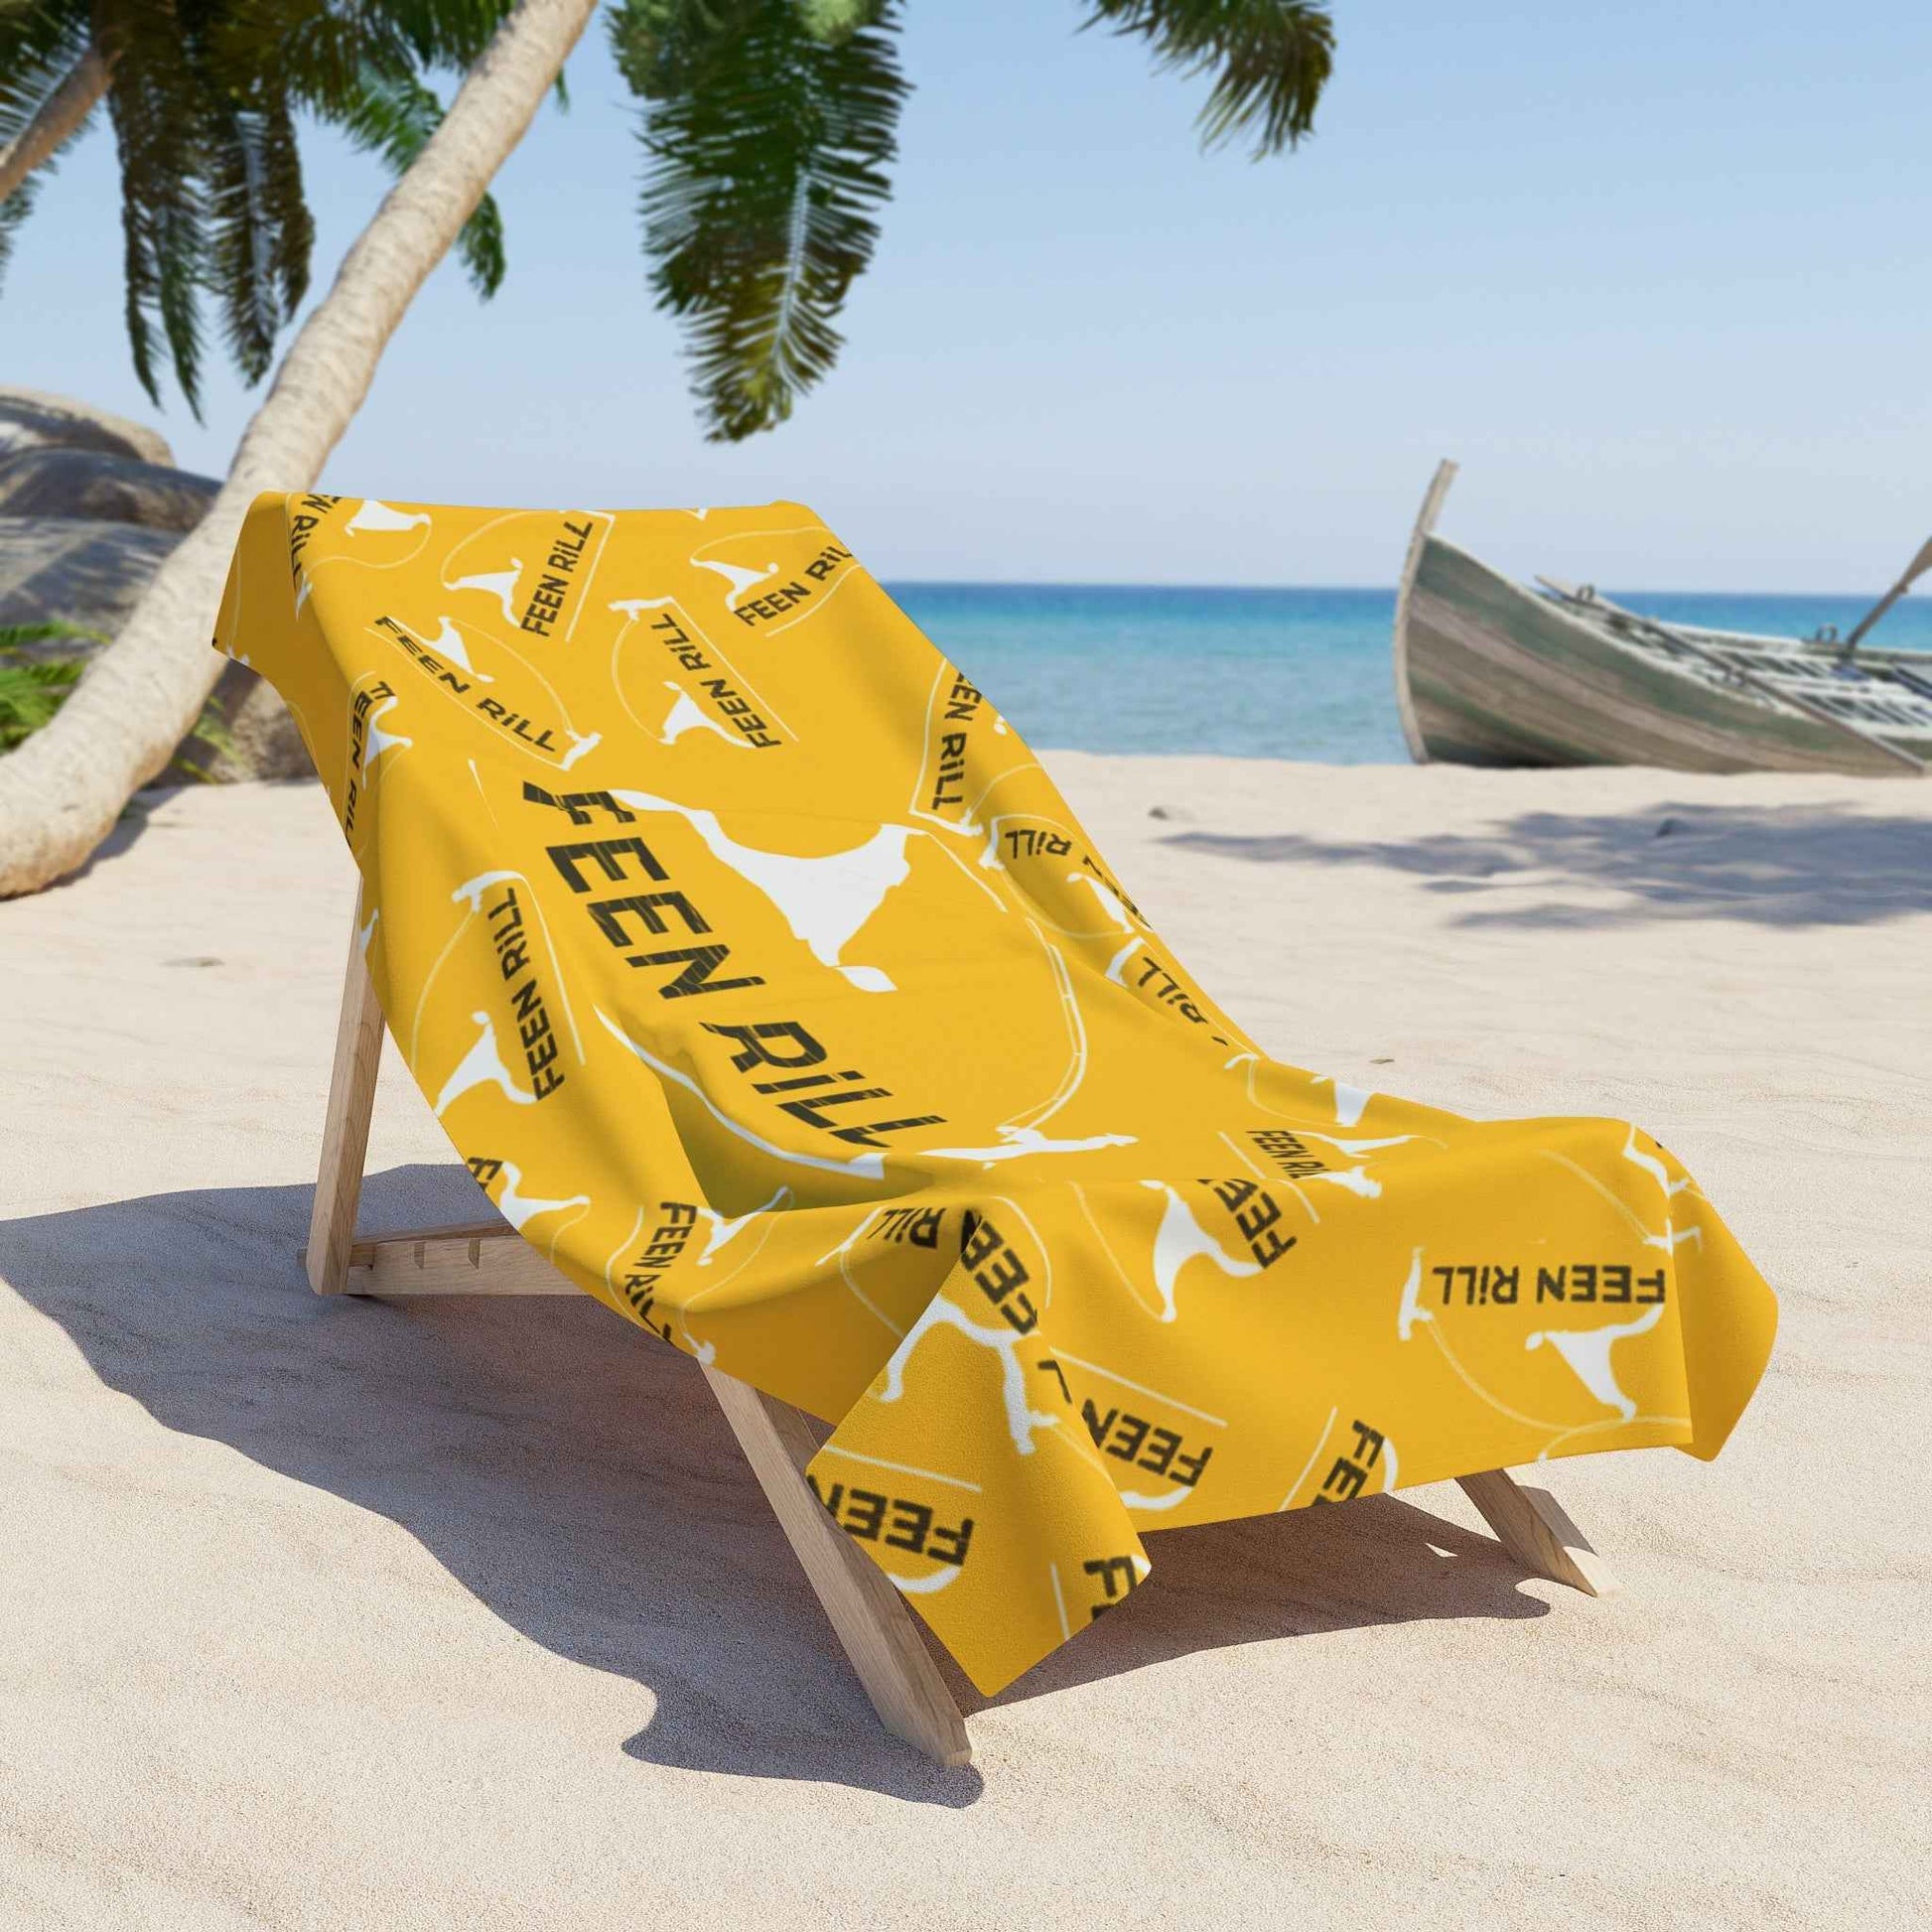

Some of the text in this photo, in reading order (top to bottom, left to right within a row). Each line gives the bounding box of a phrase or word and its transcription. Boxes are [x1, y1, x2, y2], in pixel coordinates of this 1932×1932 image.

[520, 574, 569, 637] FEEN
[733, 581, 811, 626] FEEN
[374, 616, 471, 694] FEEN
[700, 678, 782, 749] FEEN
[522, 781, 765, 1000] FEEN
[511, 980, 565, 1101] FEEN
[633, 1201, 698, 1269] FEEN
[1536, 1264, 1666, 1305] FEEN
